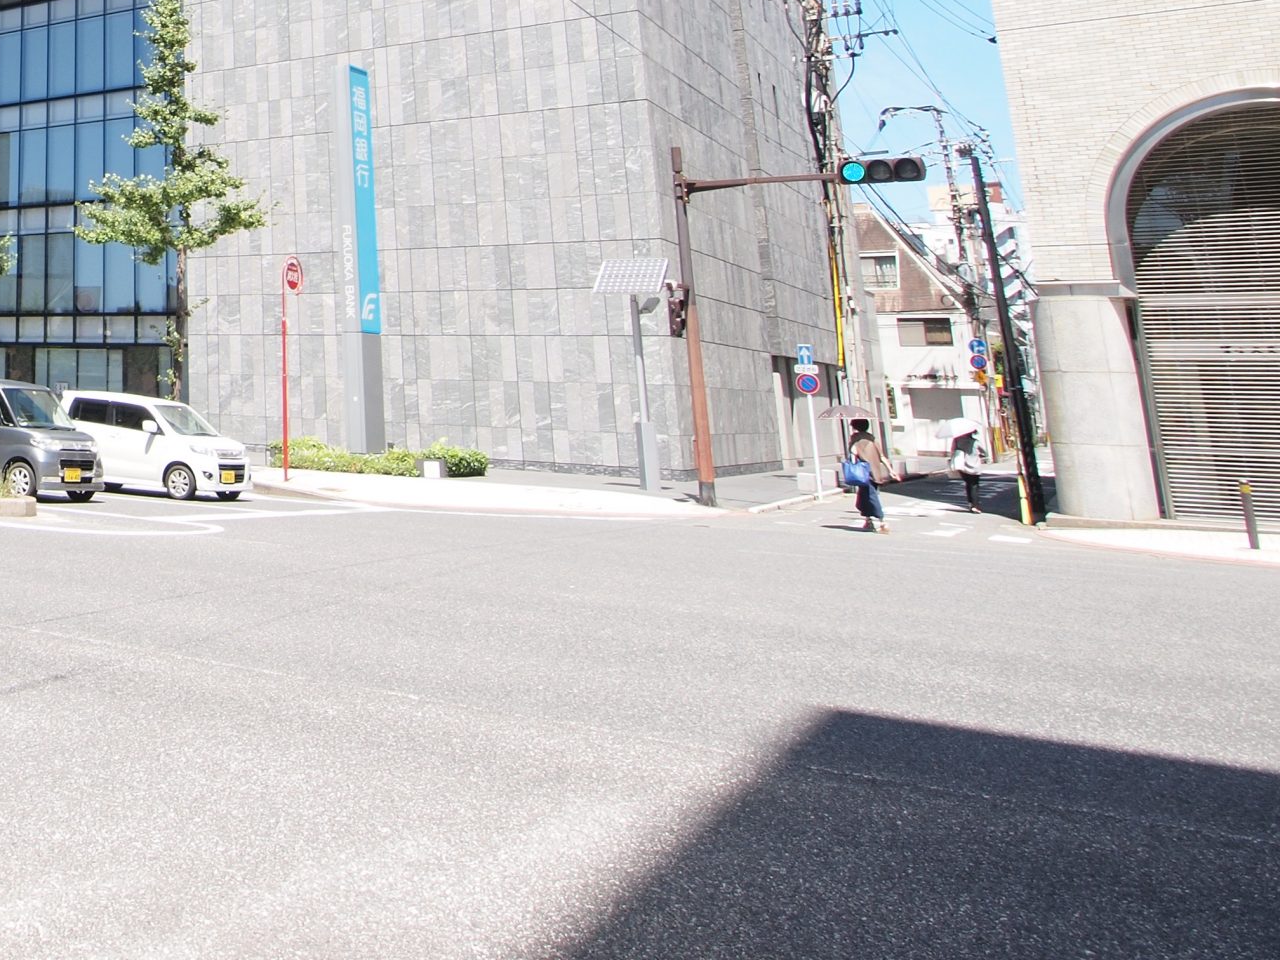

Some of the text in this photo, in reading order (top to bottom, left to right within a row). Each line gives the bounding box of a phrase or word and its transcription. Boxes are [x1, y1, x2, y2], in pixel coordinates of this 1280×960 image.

[352, 86, 369, 188] 福岡銀行
[342, 224, 356, 319] FUKUOKA BANK
